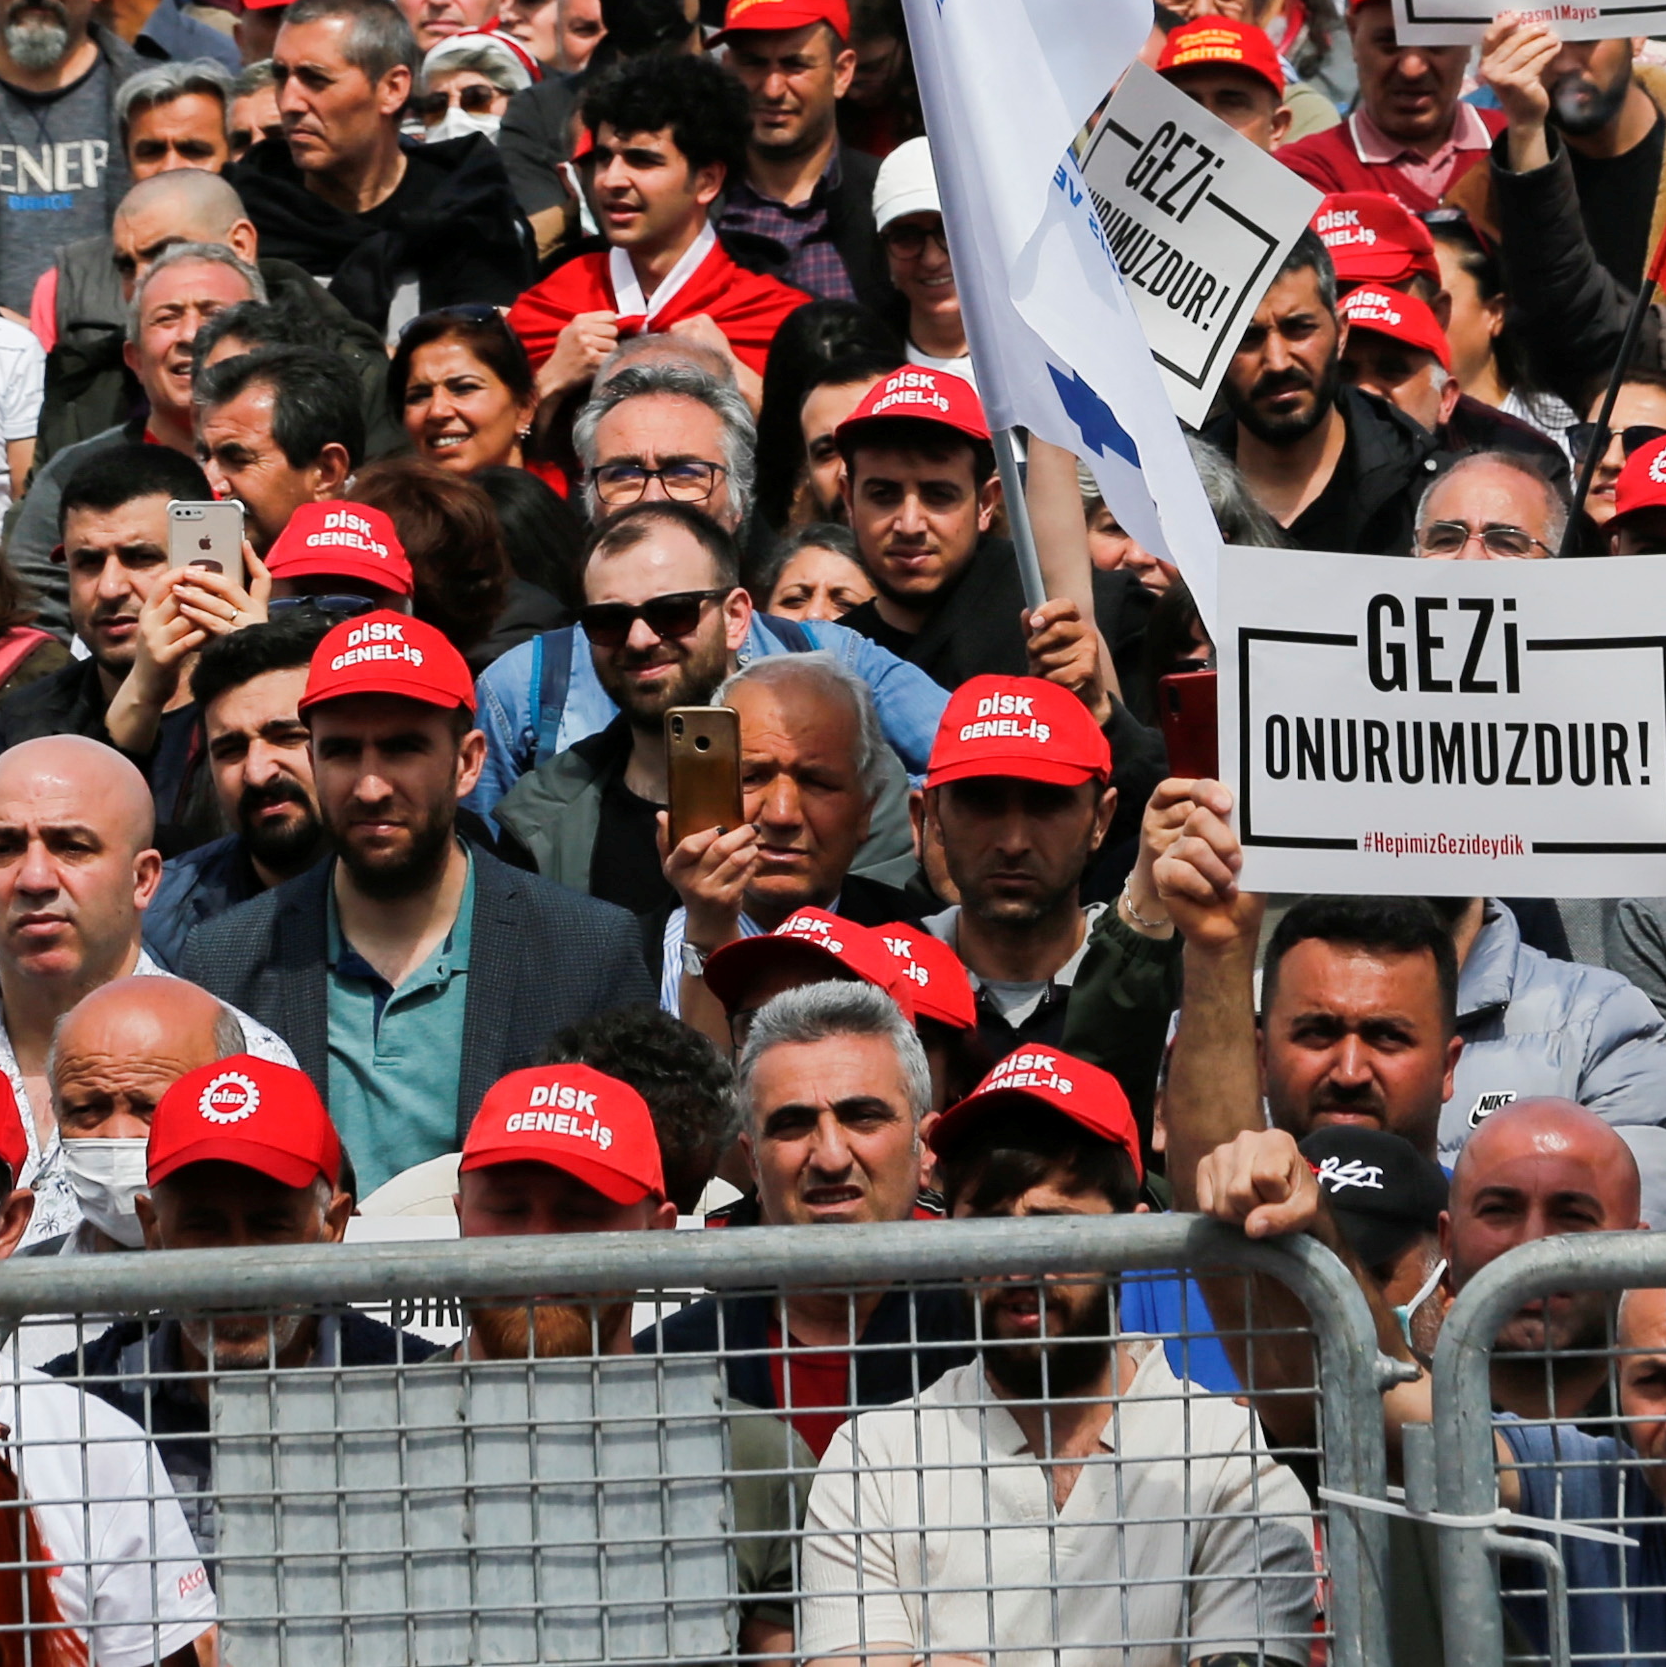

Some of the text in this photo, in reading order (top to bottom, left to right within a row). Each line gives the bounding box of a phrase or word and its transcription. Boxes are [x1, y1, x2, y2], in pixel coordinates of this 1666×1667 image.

[1123, 121, 1225, 223] GEZİ
[1316, 208, 1359, 231] DİSK
[1090, 187, 1231, 331] NURUMUZDUR!
[1346, 291, 1391, 311] DİSK
[1344, 305, 1402, 327] NEL-İŞ
[884, 371, 937, 394] DİSK
[871, 390, 951, 416] GENEL-İŞ
[323, 509, 372, 535] DİSK
[306, 532, 388, 559] GENEL-İŞ
[346, 621, 404, 648] DİSK
[1367, 593, 1521, 695] GEZİ
[330, 643, 423, 671] GENEL-İŞ
[977, 690, 1034, 717] DİSK
[958, 717, 1051, 743] GENEL-İŞ
[1264, 714, 1652, 787] ONURUMUZDUR!
[1363, 830, 1525, 861] #HepimizGezideydik
[992, 1051, 1057, 1076] DİSK
[210, 1087, 247, 1106] DİSK
[529, 1082, 598, 1115] DİSK
[505, 1112, 613, 1151] GENEL-İŞ
